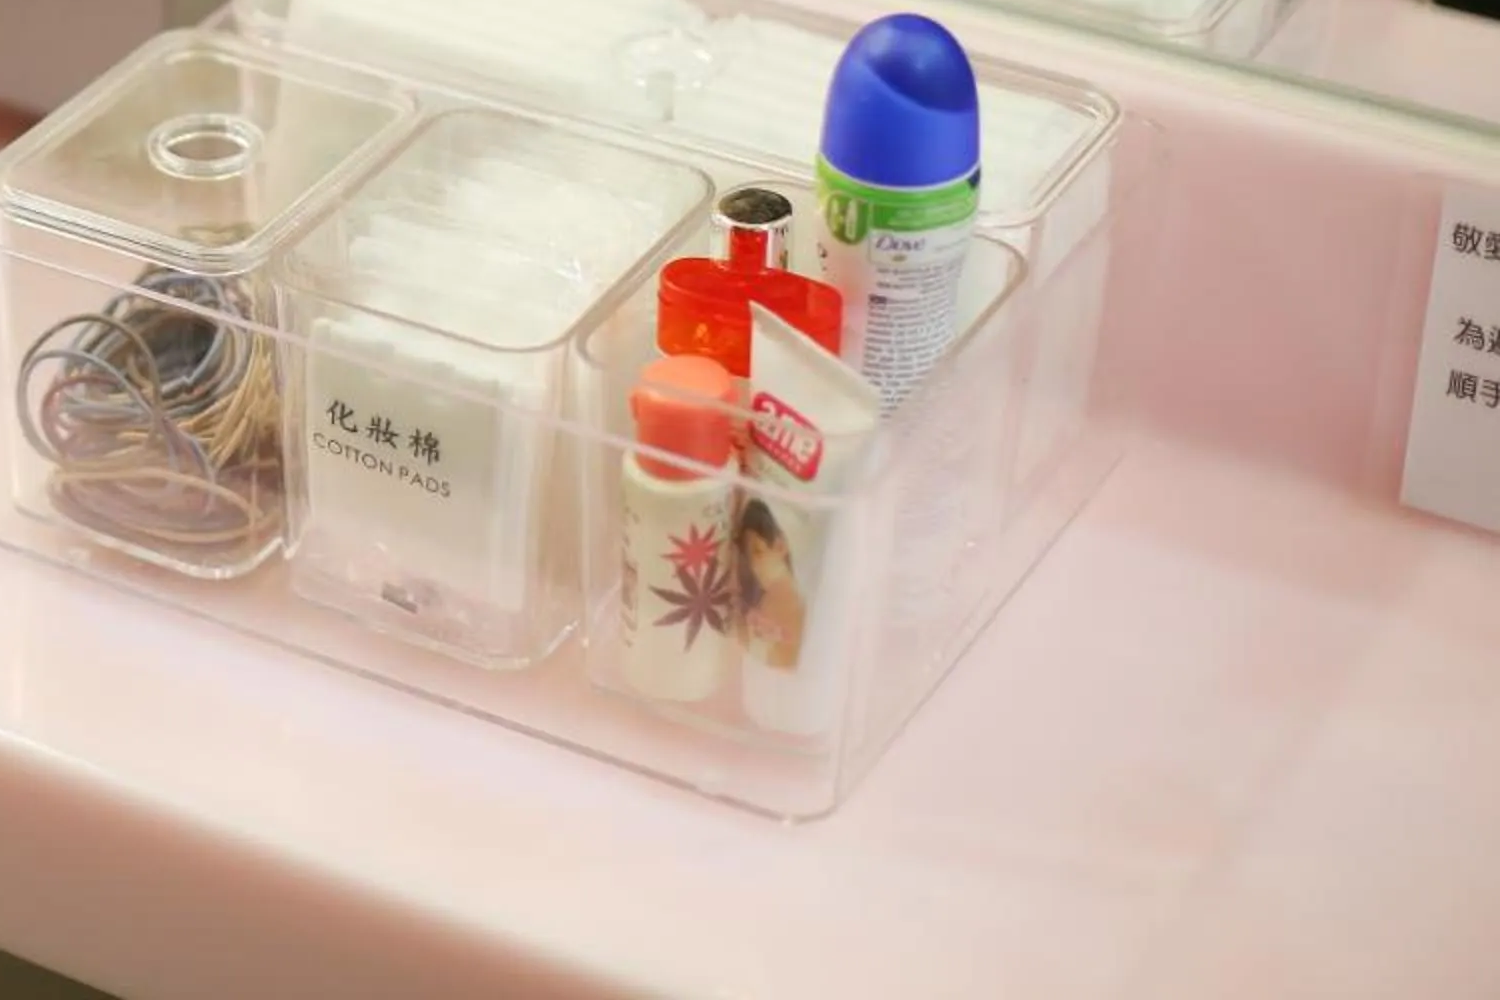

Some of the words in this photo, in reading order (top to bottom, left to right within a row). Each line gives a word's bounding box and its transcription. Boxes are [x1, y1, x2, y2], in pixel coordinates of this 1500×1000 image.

[312, 432, 394, 477] COTTON
[399, 465, 452, 499] PADS
[325, 399, 441, 466] 化妝棉
